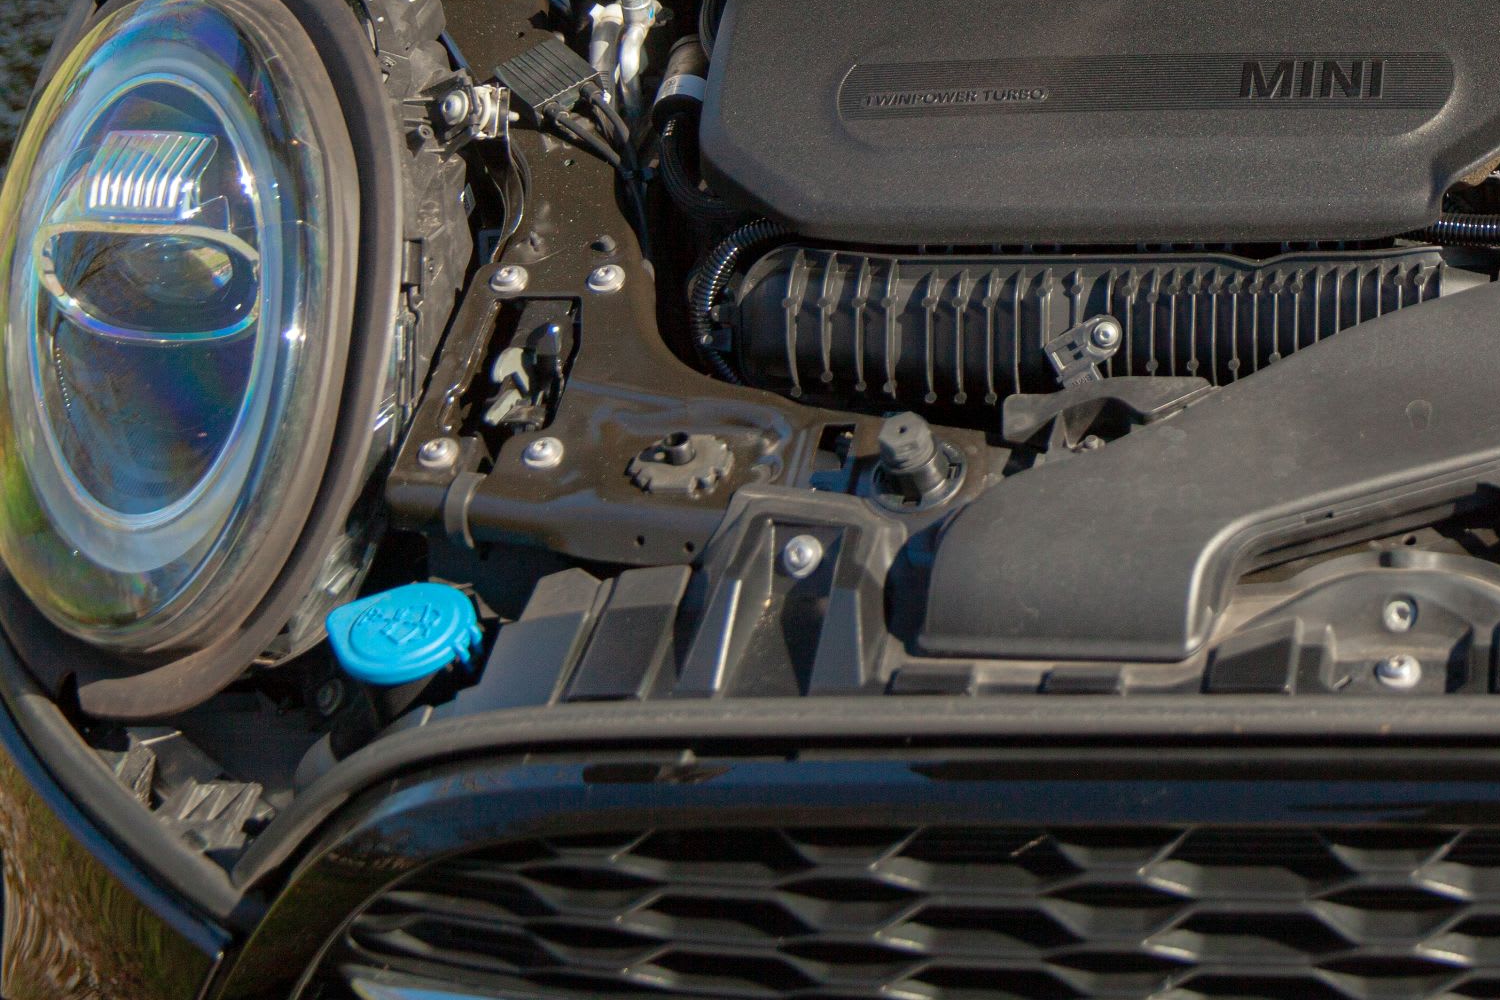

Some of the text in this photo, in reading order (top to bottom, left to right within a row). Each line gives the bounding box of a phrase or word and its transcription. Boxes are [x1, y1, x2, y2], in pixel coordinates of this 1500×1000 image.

[1239, 60, 1385, 99] MINI
[865, 88, 1044, 107] TWINPOWER TURBO
